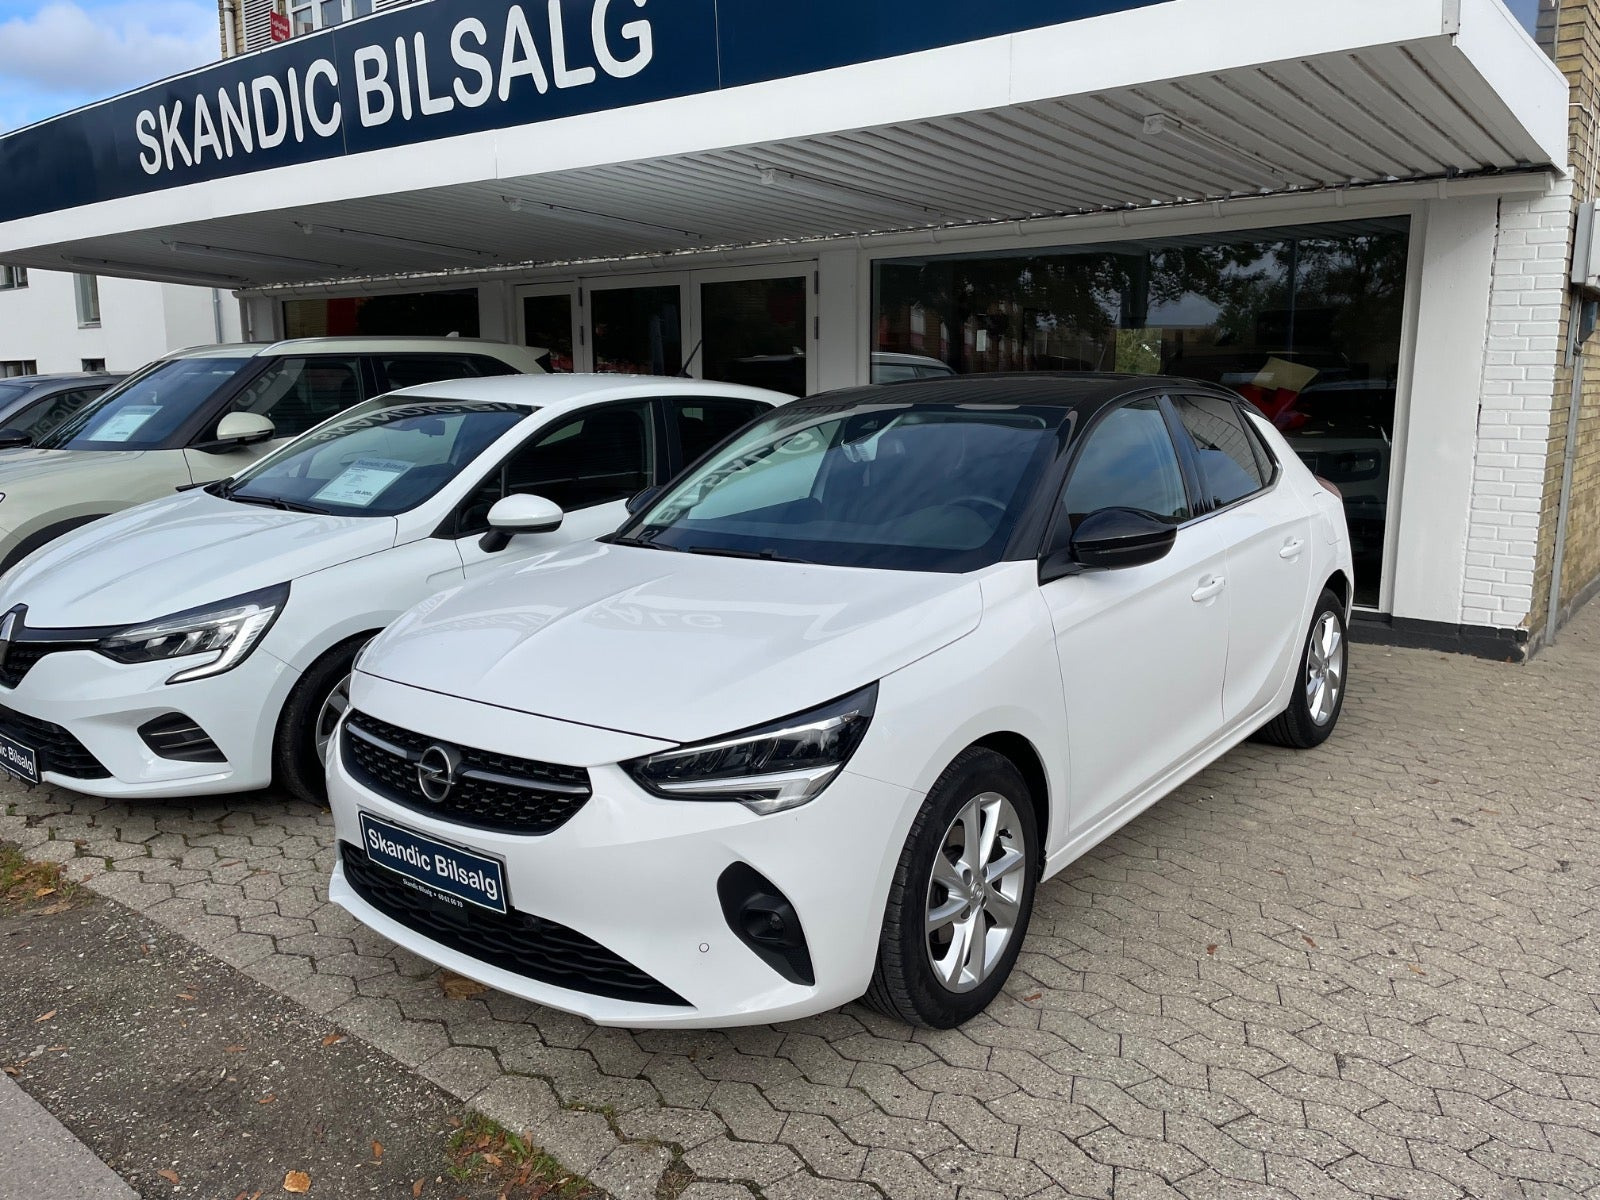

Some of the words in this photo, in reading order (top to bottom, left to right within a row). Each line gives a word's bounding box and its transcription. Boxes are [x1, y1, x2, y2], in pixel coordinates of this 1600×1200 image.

[135, 58, 342, 175] SKANDIC
[353, 0, 654, 128] BILSALG
[8, 746, 34, 775] Bilsalg
[367, 828, 431, 871] Skandic
[434, 854, 498, 900] Bilsalg
